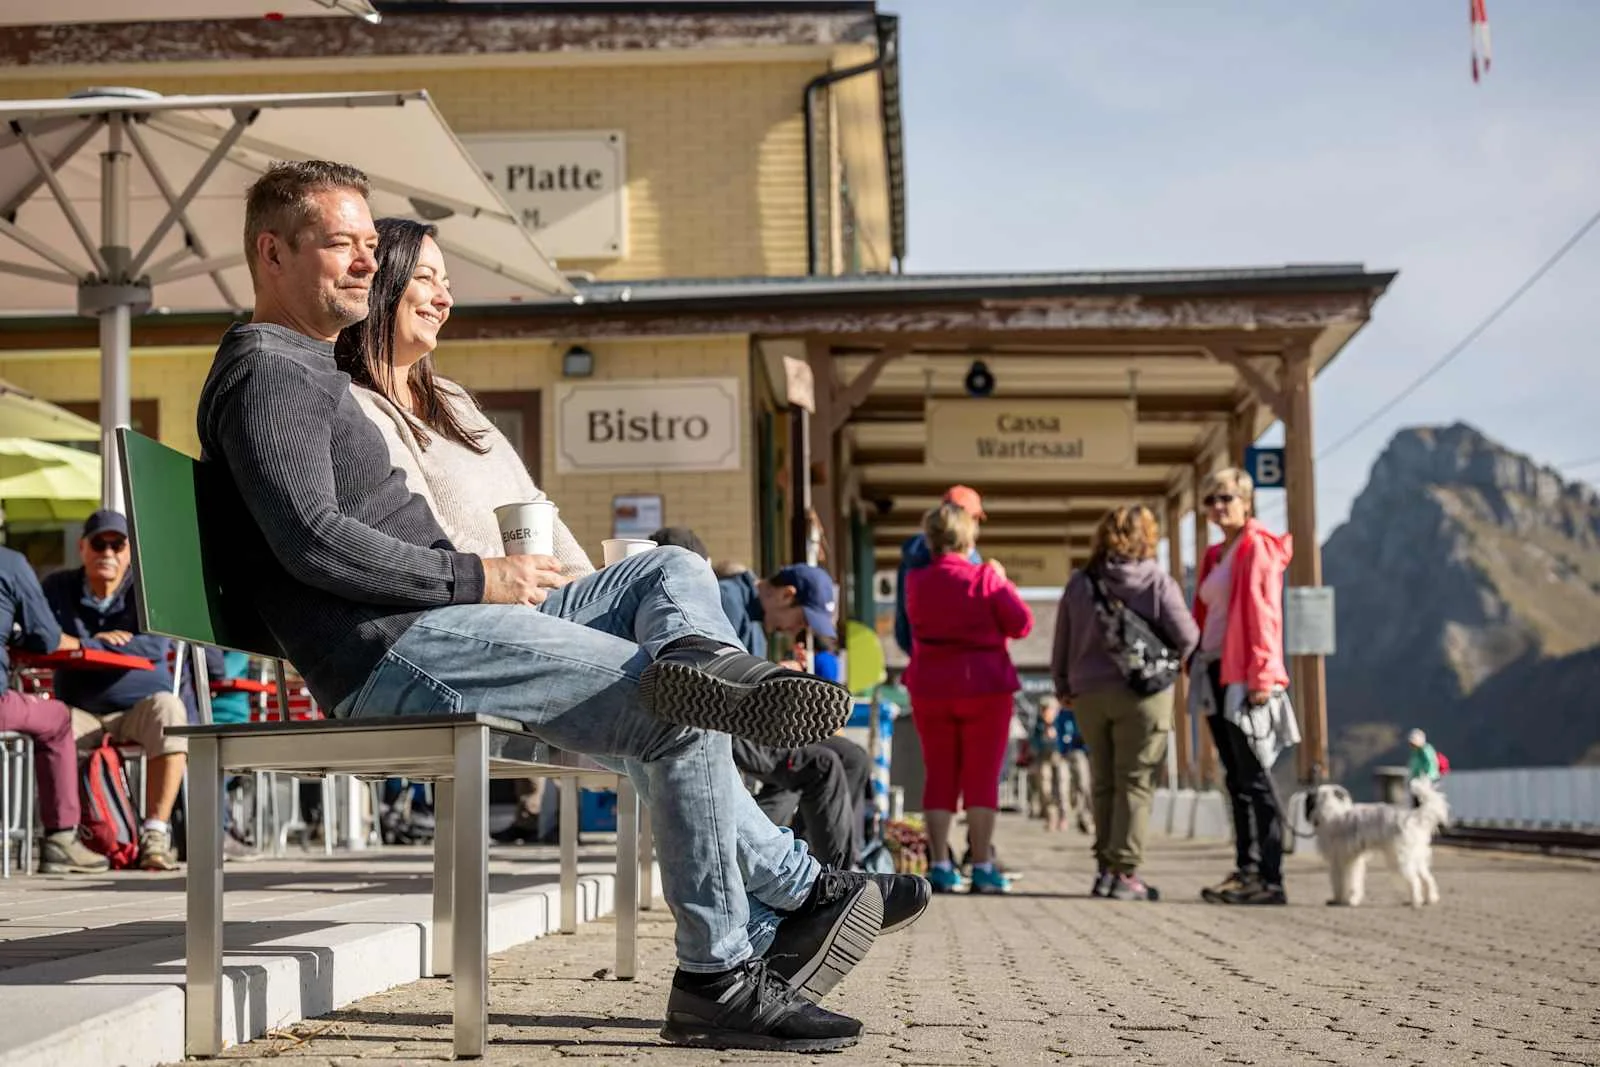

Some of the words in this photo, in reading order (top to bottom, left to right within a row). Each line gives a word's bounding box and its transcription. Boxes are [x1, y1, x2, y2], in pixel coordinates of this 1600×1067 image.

[506, 163, 603, 192] Platte
[587, 408, 709, 443] Bistro
[996, 412, 1061, 433] Cassa
[976, 436, 1084, 459] Wartesaal
[1256, 452, 1282, 485] B
